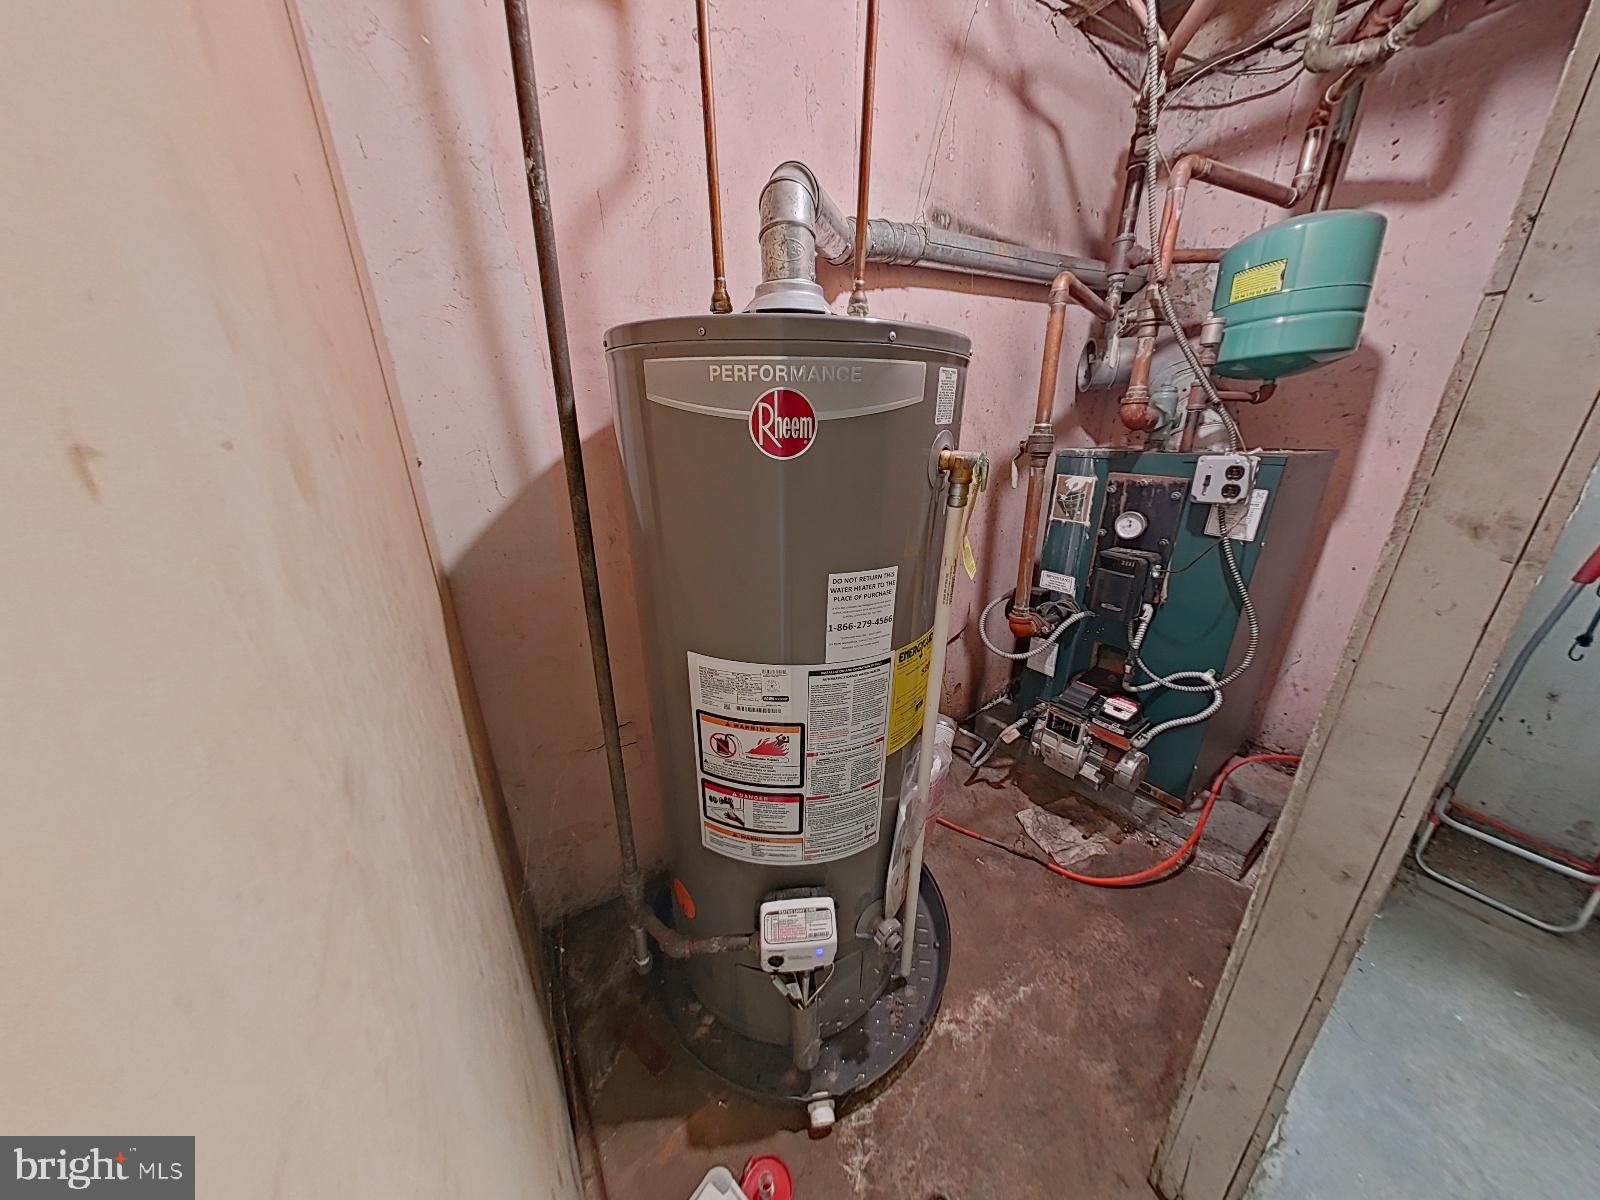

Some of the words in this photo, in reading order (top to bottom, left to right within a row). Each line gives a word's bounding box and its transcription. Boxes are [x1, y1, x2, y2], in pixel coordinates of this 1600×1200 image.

[709, 364, 862, 382] PERFORMANCE
[758, 390, 813, 448] Rheem
[858, 573, 882, 582] RETURN
[830, 586, 852, 594] WATER
[853, 583, 876, 592] HEATER
[863, 589, 892, 599] PURCHASE
[828, 615, 893, 632] 1-866-279-4566
[733, 724, 770, 732] WARNING
[739, 793, 768, 801] DANGER
